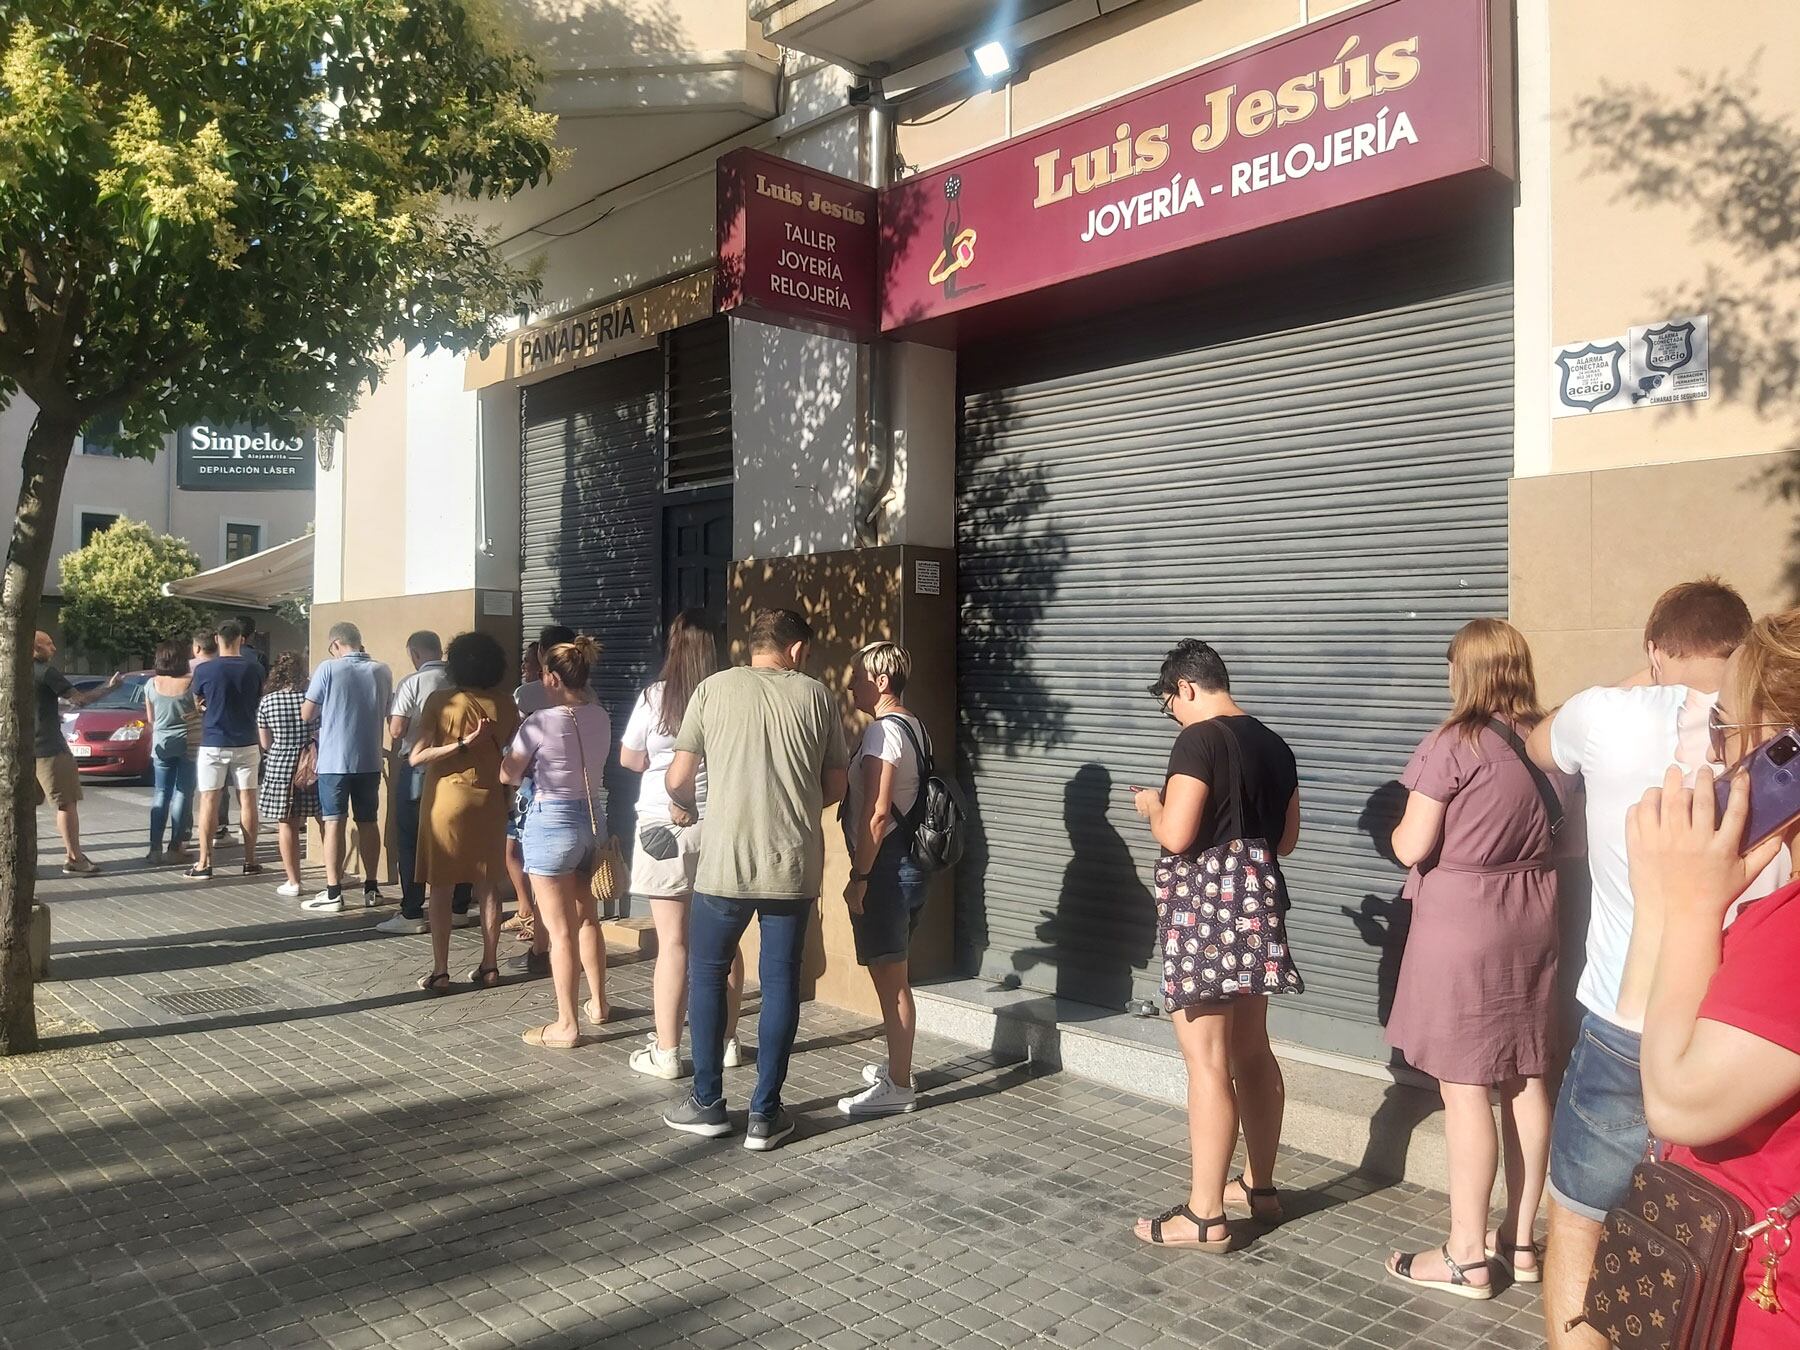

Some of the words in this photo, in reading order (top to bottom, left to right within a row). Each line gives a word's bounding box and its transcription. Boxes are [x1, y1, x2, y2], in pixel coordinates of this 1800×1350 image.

[1033, 122, 1170, 208] Luis
[1191, 35, 1420, 153] Jesús
[1081, 172, 1204, 242] JOYERÍA
[1231, 106, 1419, 197] RELOJERÍA
[756, 174, 802, 206] Luis
[808, 192, 865, 225] Jesús
[785, 222, 836, 253] TALLER
[778, 249, 843, 282] JOYERÍA
[771, 274, 851, 310] RELOJERÍA
[521, 306, 635, 369] PANADERIA
[1570, 361, 1609, 373] CONECTADA
[1577, 356, 1603, 365] ALARMA
[1652, 352, 1685, 363] acacio
[1568, 381, 1611, 396] acacio
[199, 466, 260, 474] DEPILACIÓN
[263, 466, 296, 474] LÁSER
